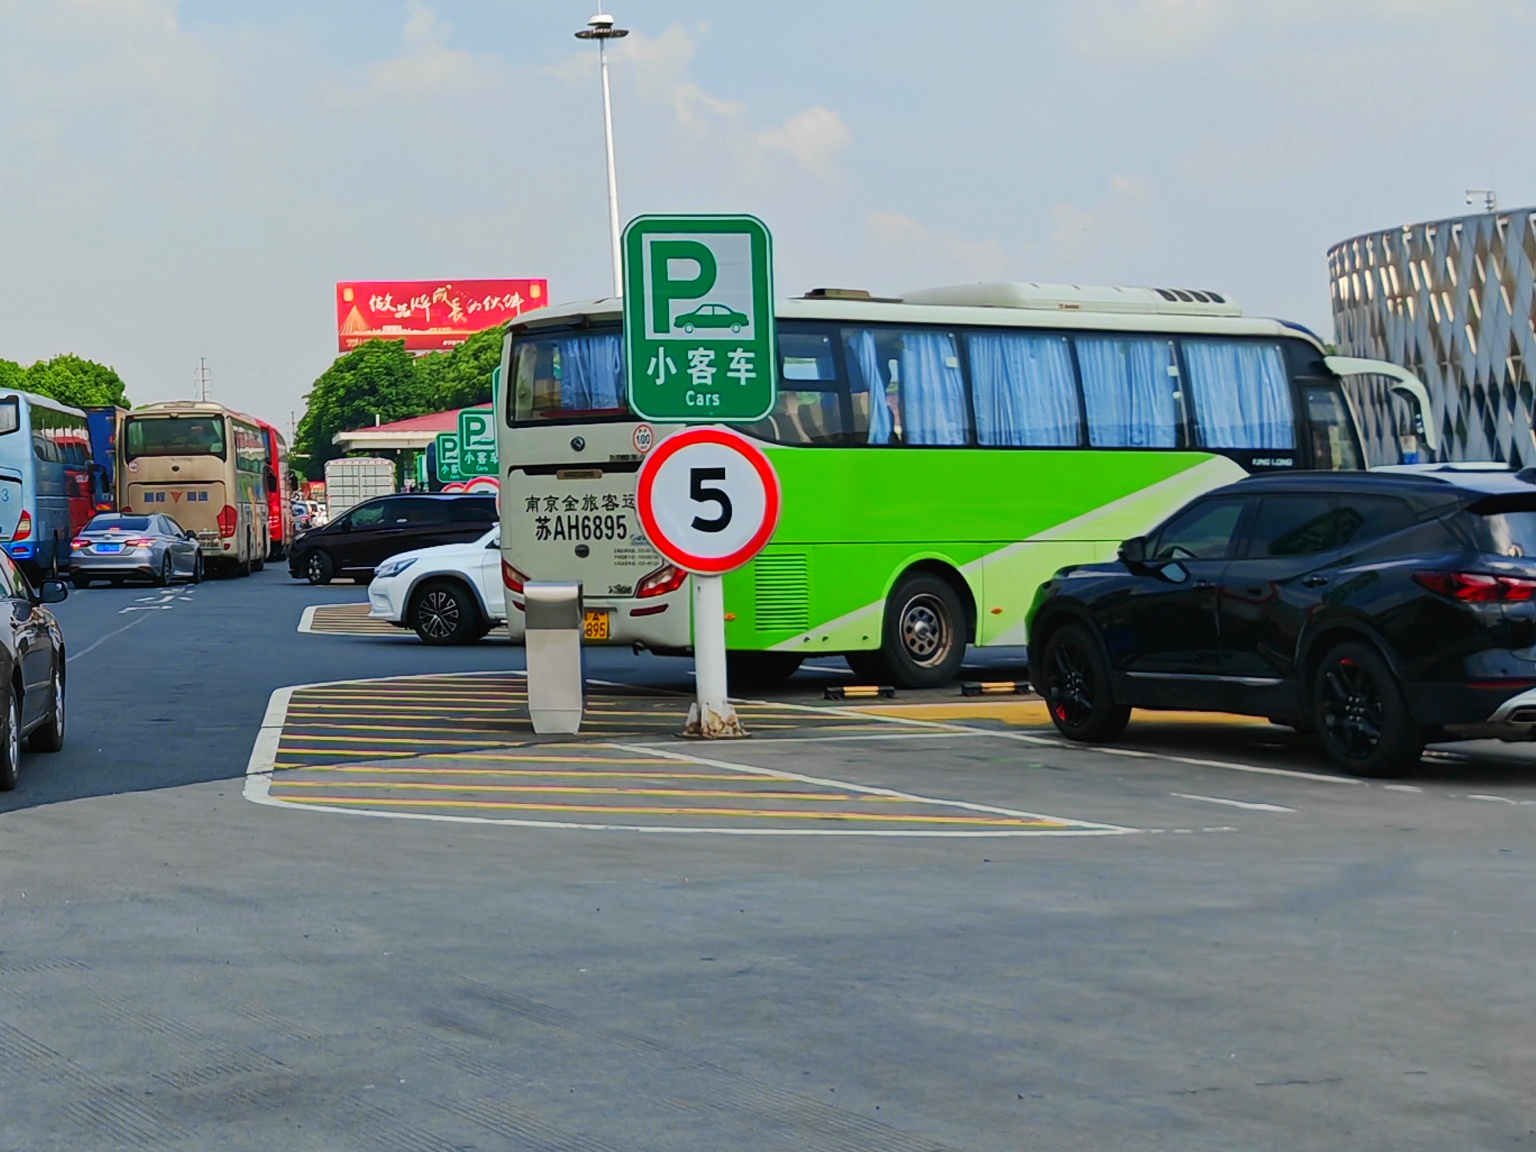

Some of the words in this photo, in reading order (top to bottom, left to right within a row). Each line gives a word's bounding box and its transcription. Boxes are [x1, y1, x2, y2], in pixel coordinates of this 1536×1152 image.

[650, 240, 717, 334] P
[646, 346, 757, 386] 小客车
[685, 390, 720, 406] Cars
[690, 467, 733, 533] 5
[534, 514, 627, 542] 苏AH6895
